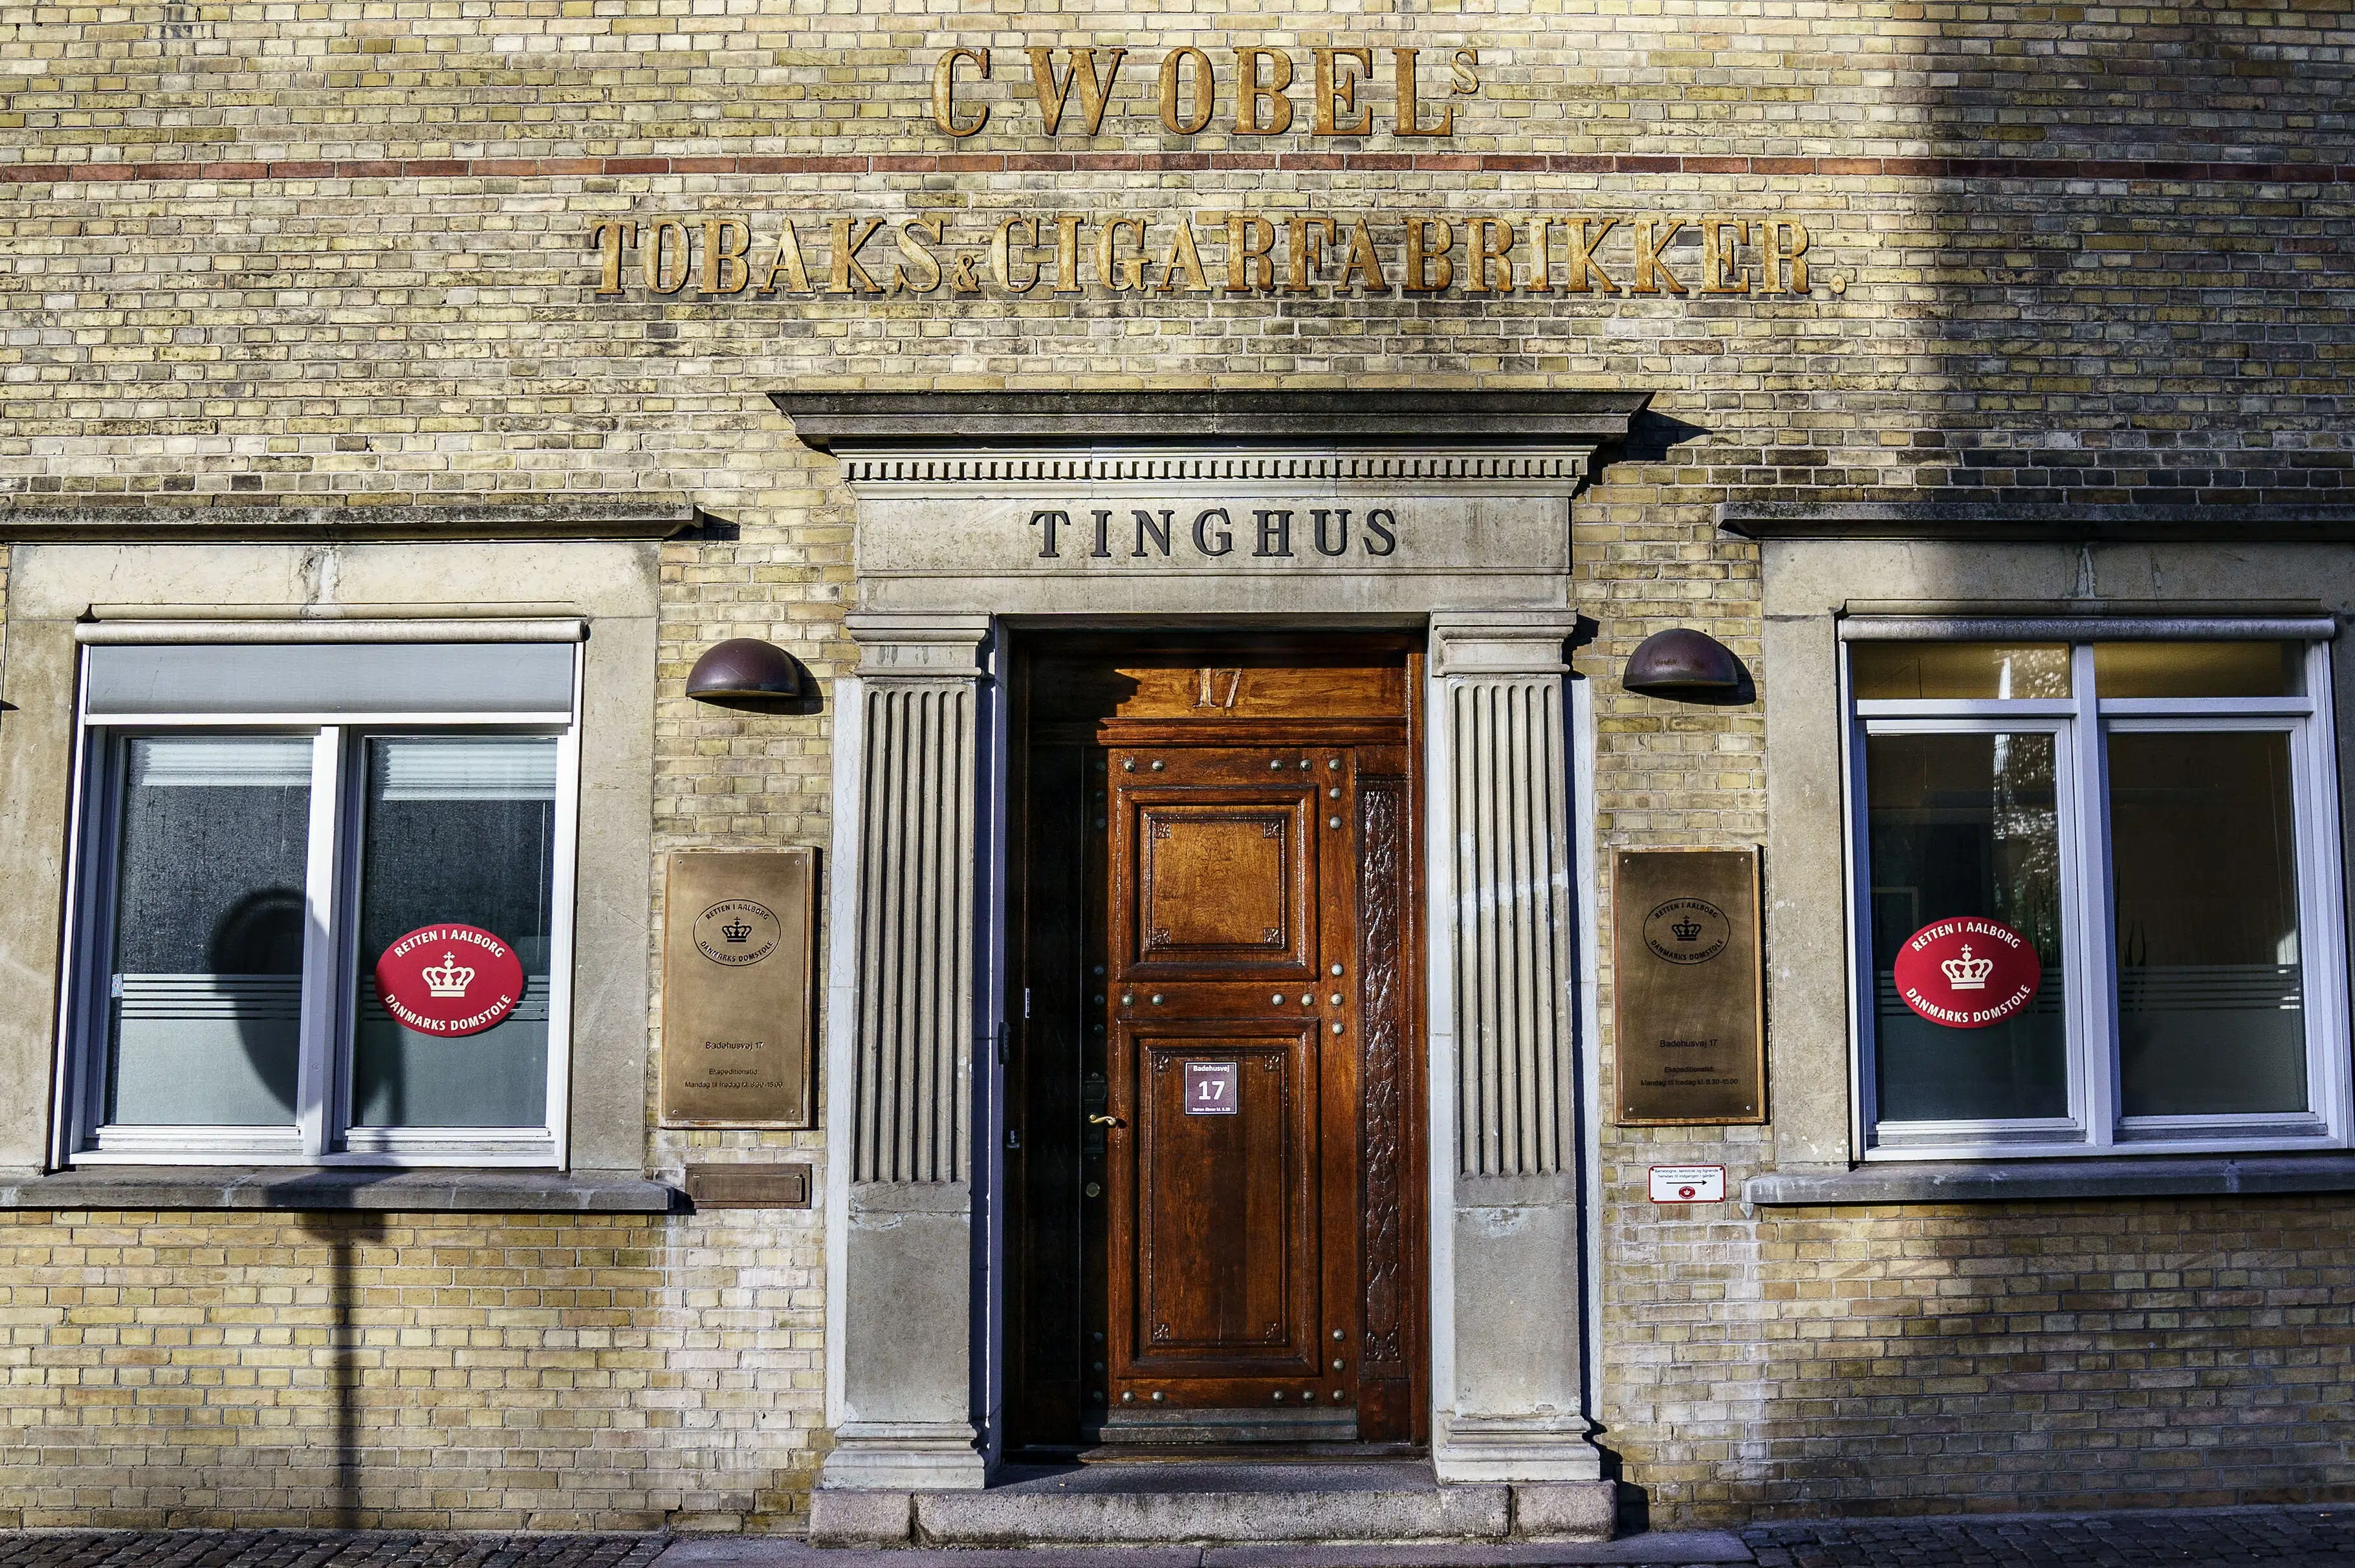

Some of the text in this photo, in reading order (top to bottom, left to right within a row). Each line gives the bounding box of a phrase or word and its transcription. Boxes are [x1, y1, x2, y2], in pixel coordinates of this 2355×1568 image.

[1029, 507, 1397, 558] TINGHUS
[1193, 667, 1243, 709] 17
[705, 904, 731, 920] RETTEN
[738, 904, 769, 920] AALBORG
[1654, 902, 1680, 919] RETTEN
[1687, 902, 1719, 919] AALBORG
[393, 929, 506, 959] RETTEN I AALBORG
[1911, 921, 2021, 952] RETTEN I AALBORG
[700, 940, 774, 963] DANMARKS DOMSTOLE
[1651, 938, 1724, 961] DANMARKS DOMSTOLE
[385, 993, 512, 1031] DANMARKS DOMSTOLE
[1906, 984, 2031, 1023] DANMARKS DOMSTOLE
[705, 1041, 753, 1051] Badehusvej
[1659, 1039, 1707, 1049] Badehusvej
[1198, 1080, 1225, 1100] 17
